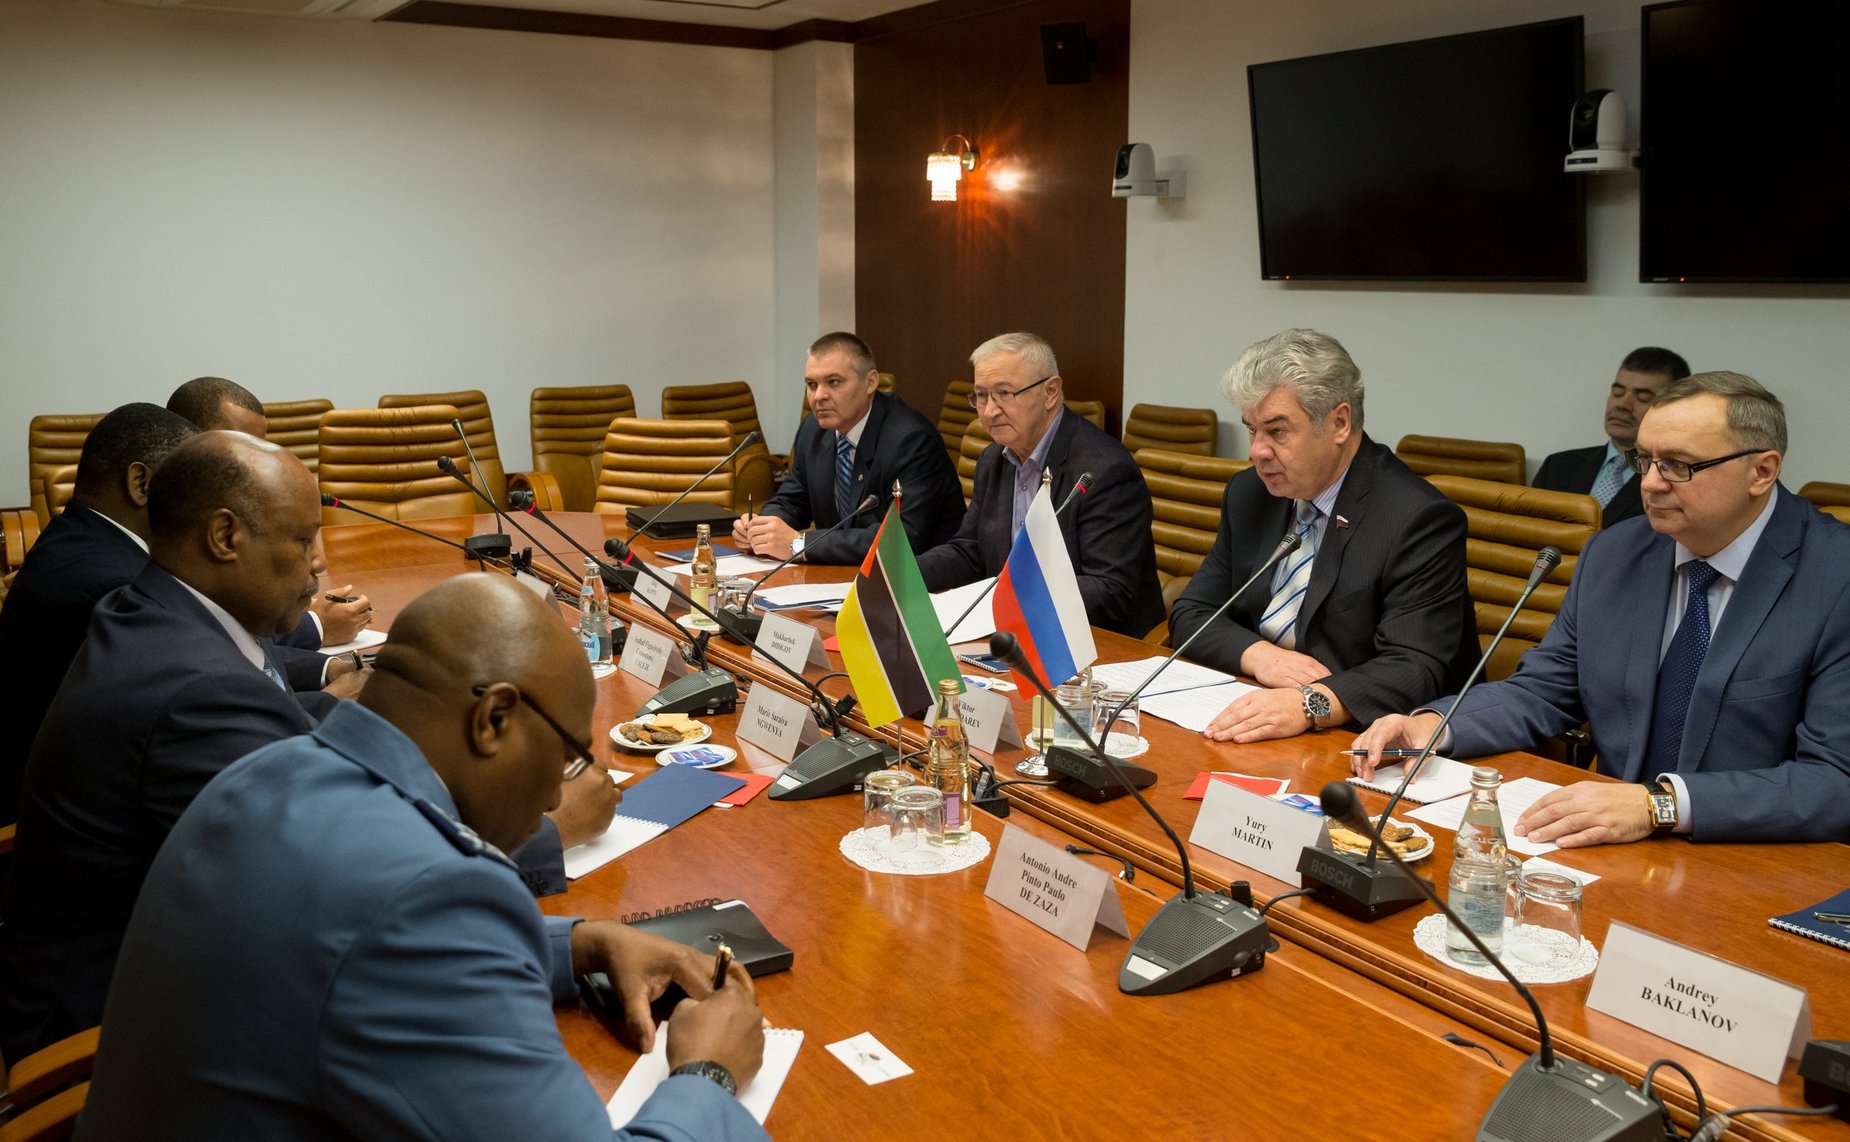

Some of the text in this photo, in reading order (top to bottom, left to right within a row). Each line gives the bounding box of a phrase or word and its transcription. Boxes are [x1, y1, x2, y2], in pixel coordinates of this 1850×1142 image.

[1054, 754, 1087, 777] BOSCH
[1231, 826, 1274, 851] MARTIN
[1245, 814, 1268, 835] Yury
[1019, 852, 1078, 889] Antonio Andre
[1021, 869, 1066, 902] Pinto Paulo
[1310, 858, 1354, 886] BOSCH
[1018, 887, 1058, 917] DE ZAZA
[1664, 976, 1719, 1007] Andrey
[1641, 987, 1738, 1034] BAKLANOV
